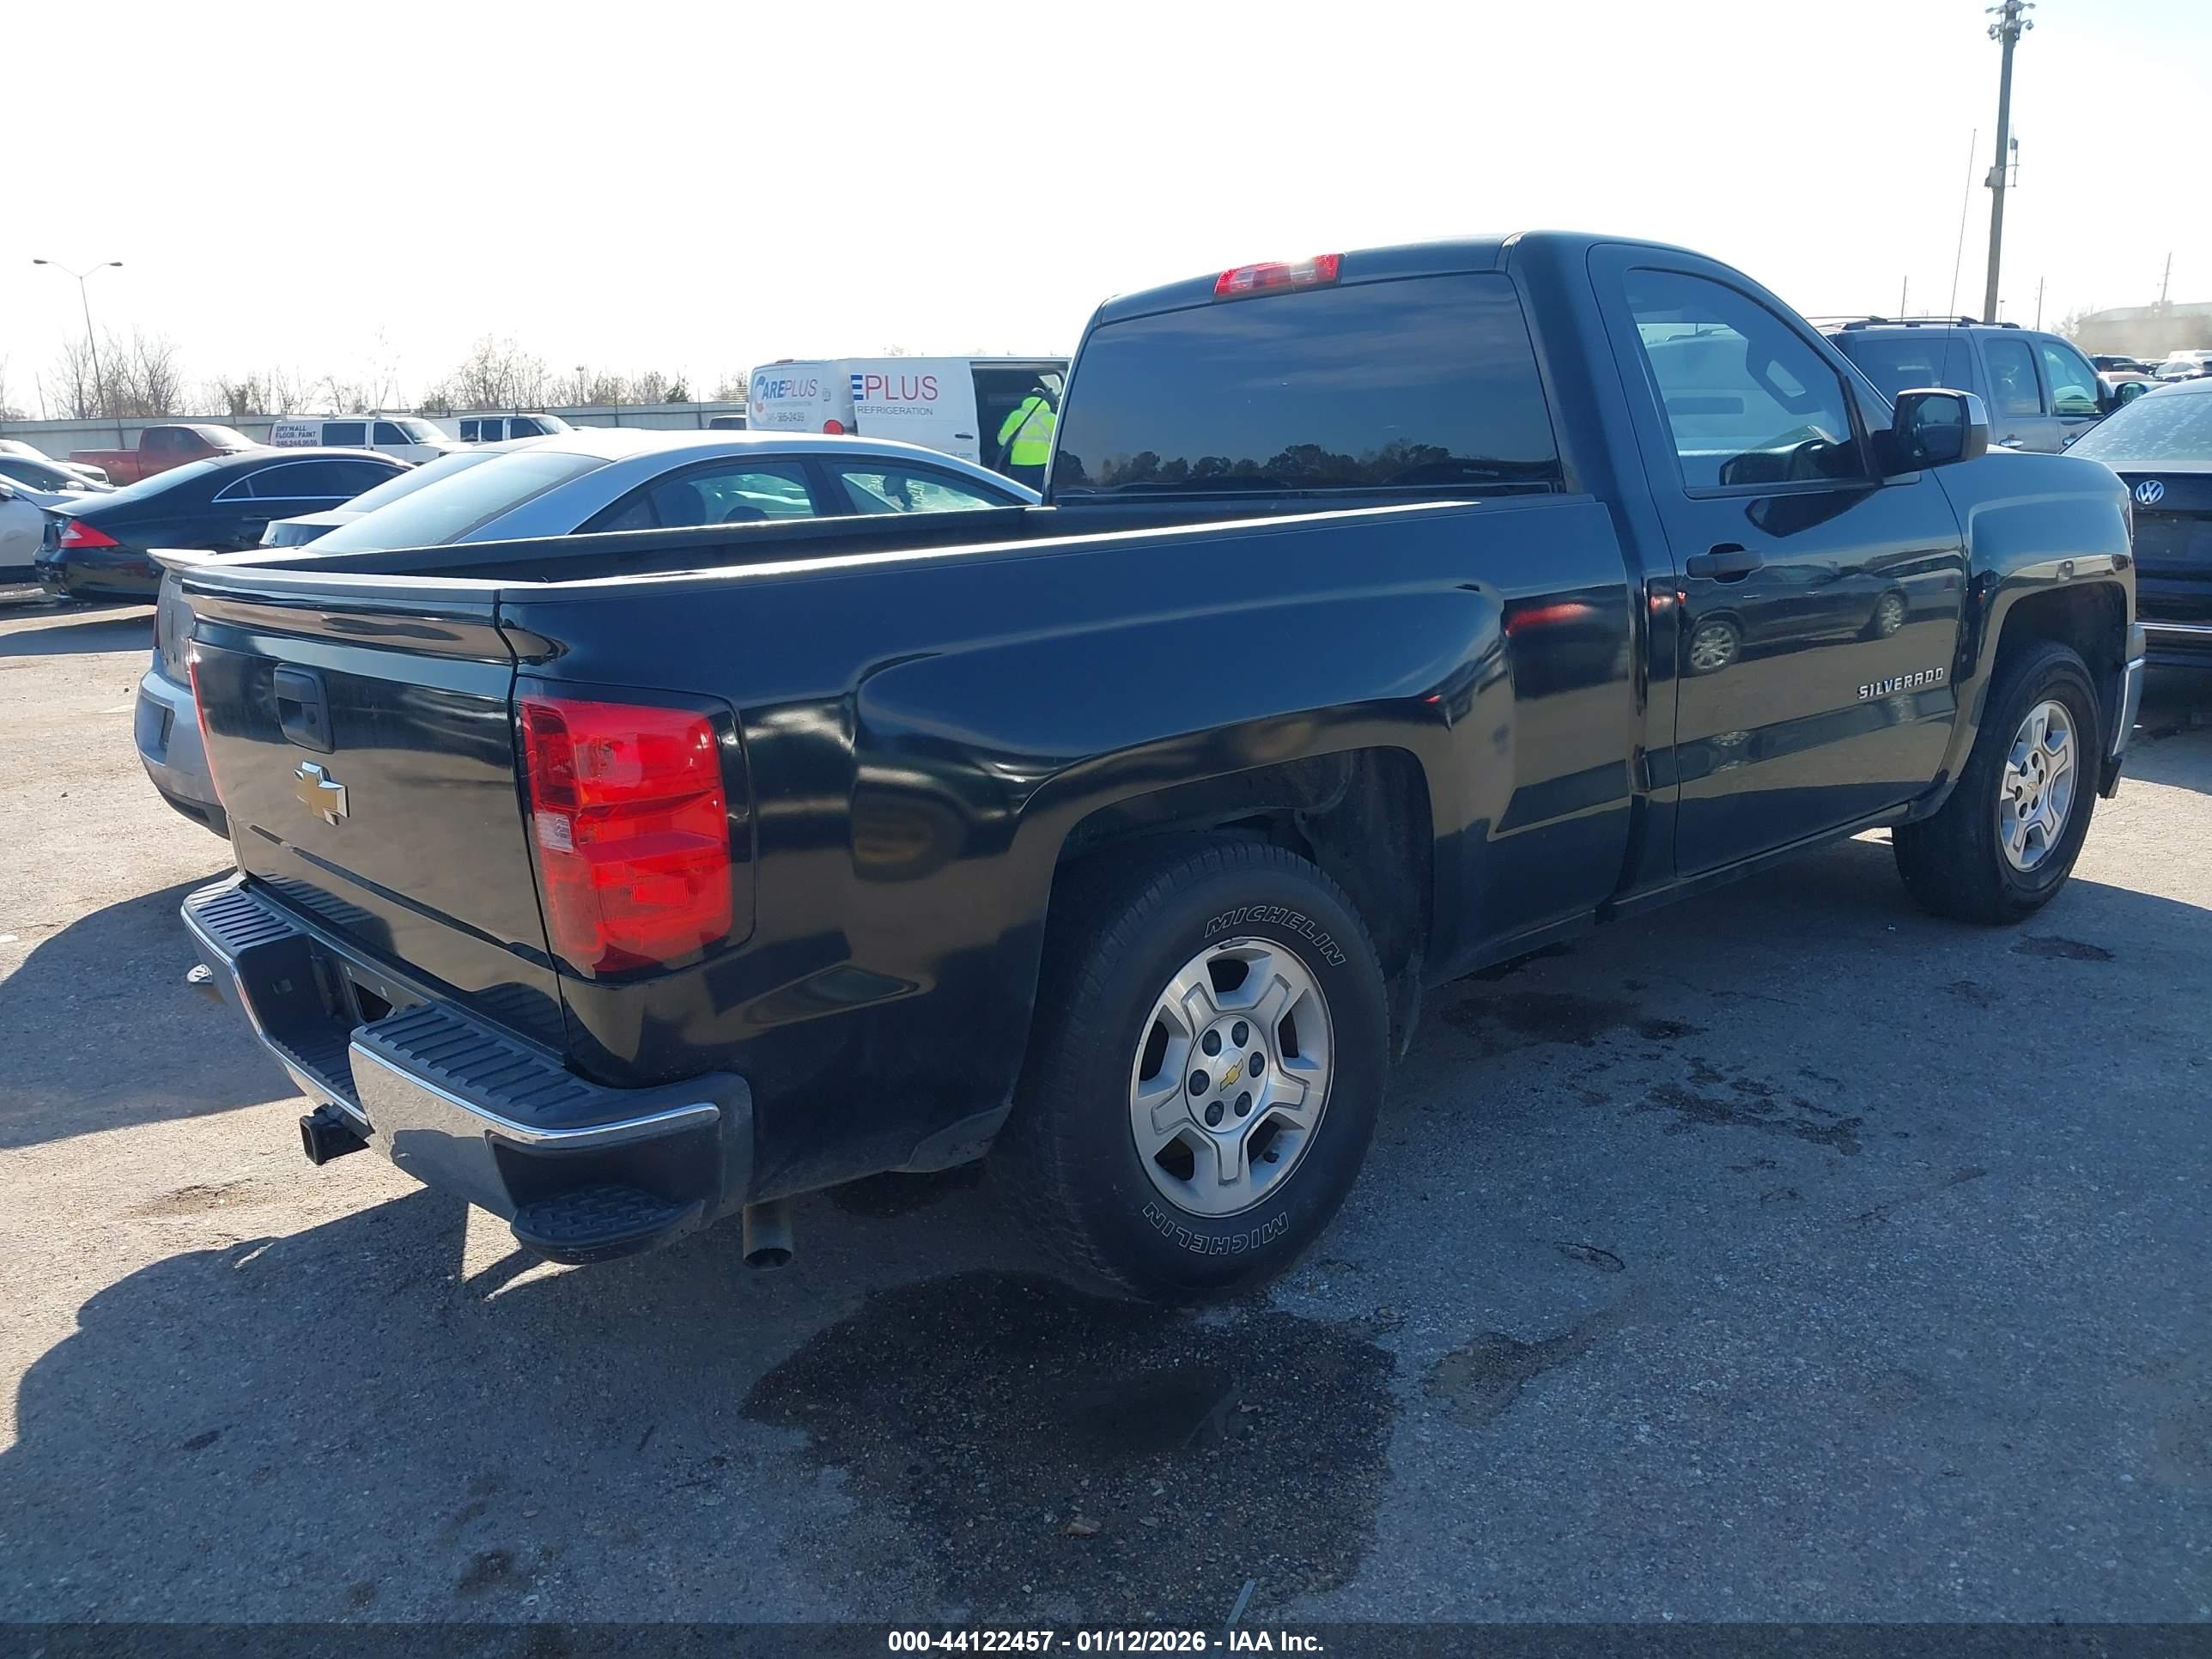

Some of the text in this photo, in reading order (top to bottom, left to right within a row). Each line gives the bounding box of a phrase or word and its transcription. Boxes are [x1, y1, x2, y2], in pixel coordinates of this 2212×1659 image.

[857, 405, 933, 416] REFRIGERATION
[1857, 667, 1944, 700] SILVERADO
[1204, 905, 1346, 967] MICHELIN
[1142, 1201, 1290, 1255] MICHELIN
